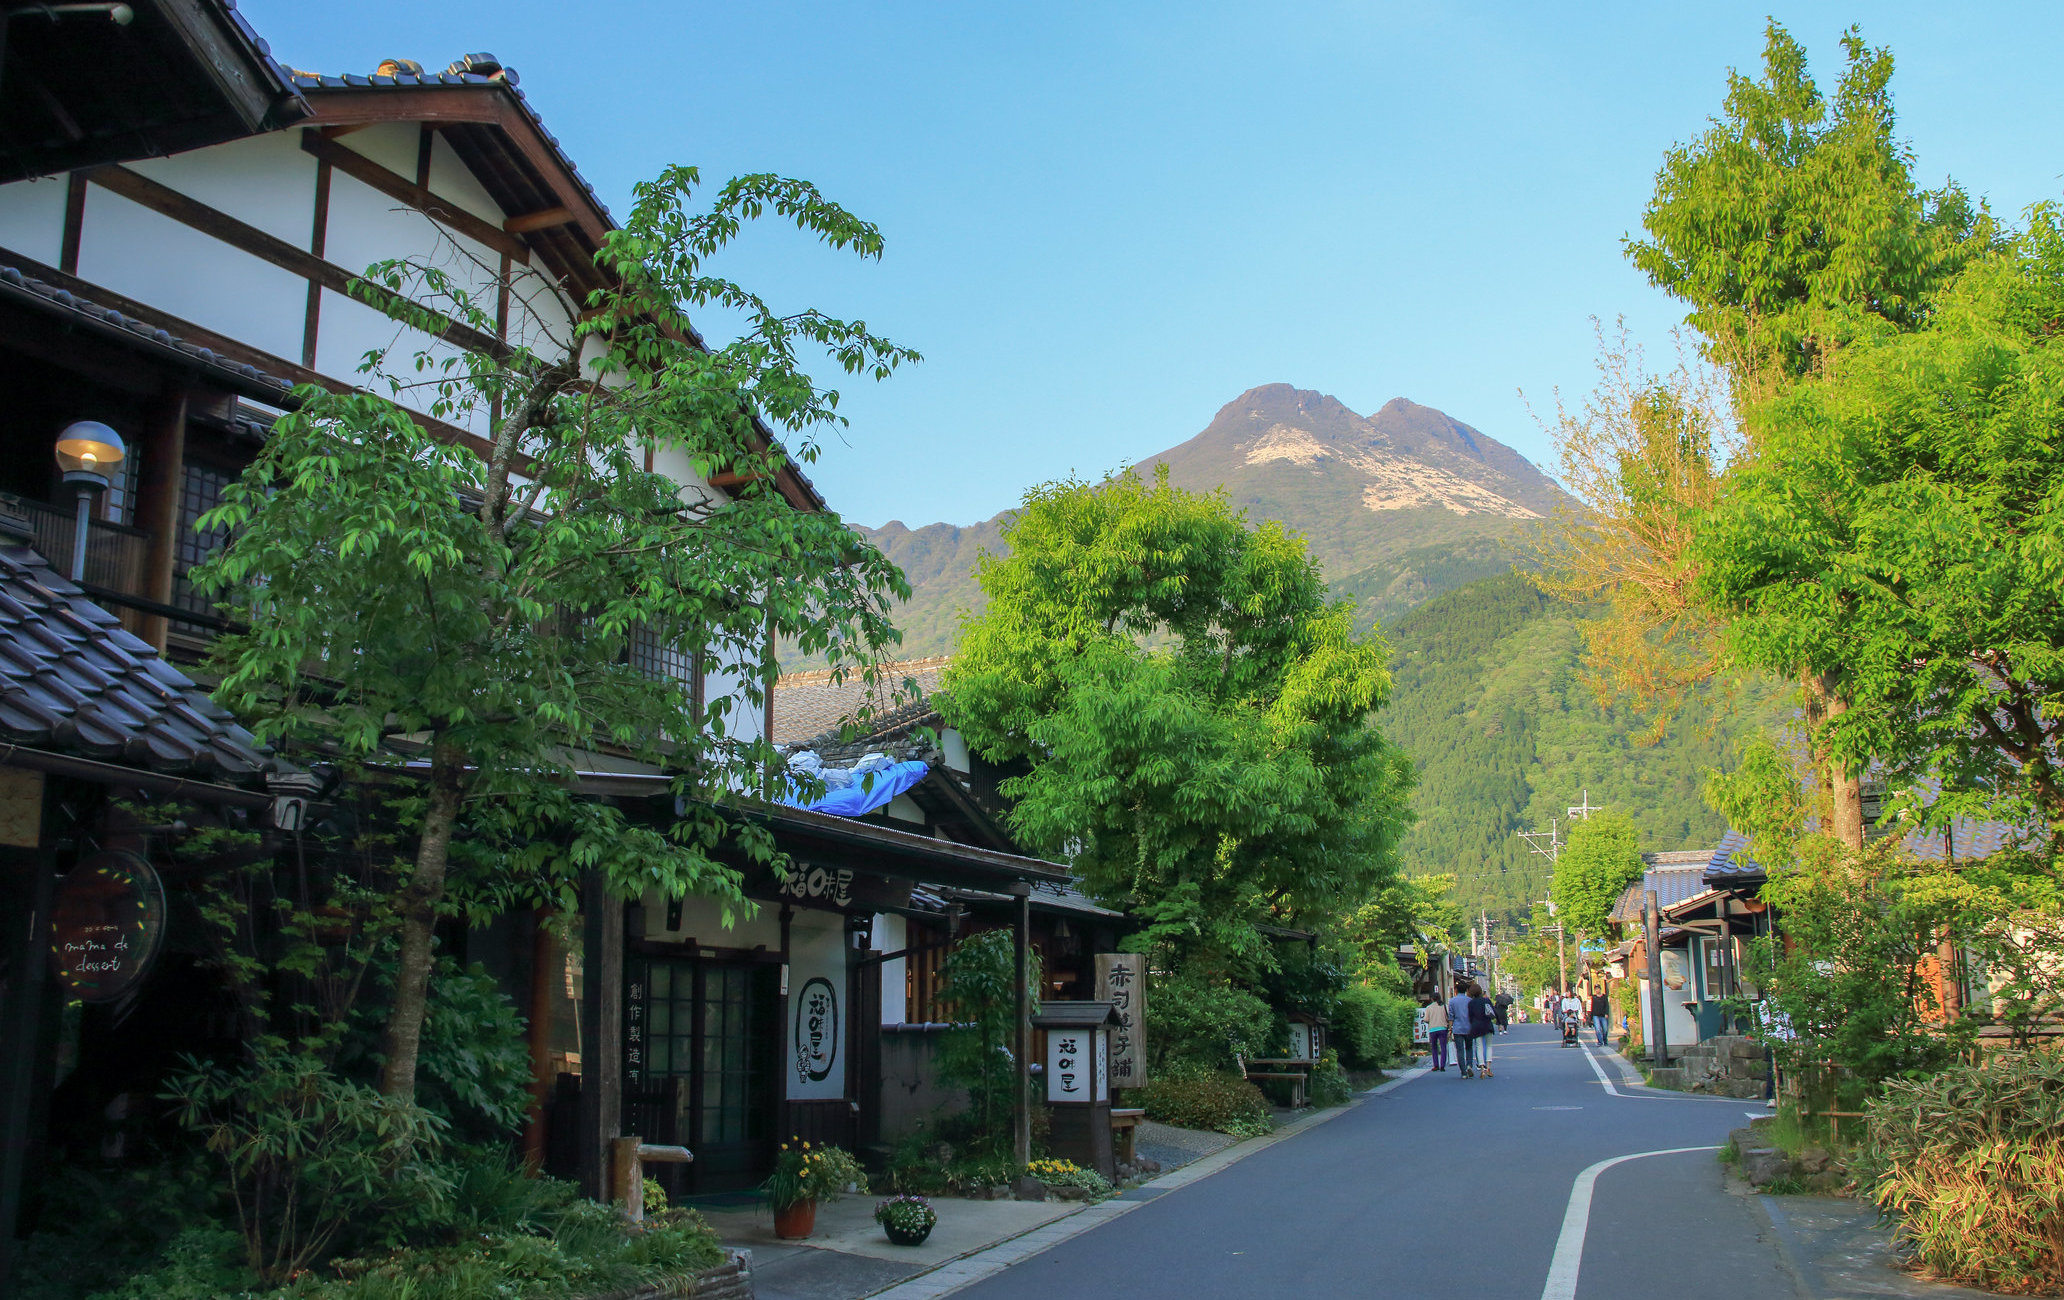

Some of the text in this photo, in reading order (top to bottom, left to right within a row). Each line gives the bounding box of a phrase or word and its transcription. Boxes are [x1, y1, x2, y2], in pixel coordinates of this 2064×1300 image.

[64, 933, 129, 953] mama de
[1058, 1038, 1080, 1093] 福味屋
